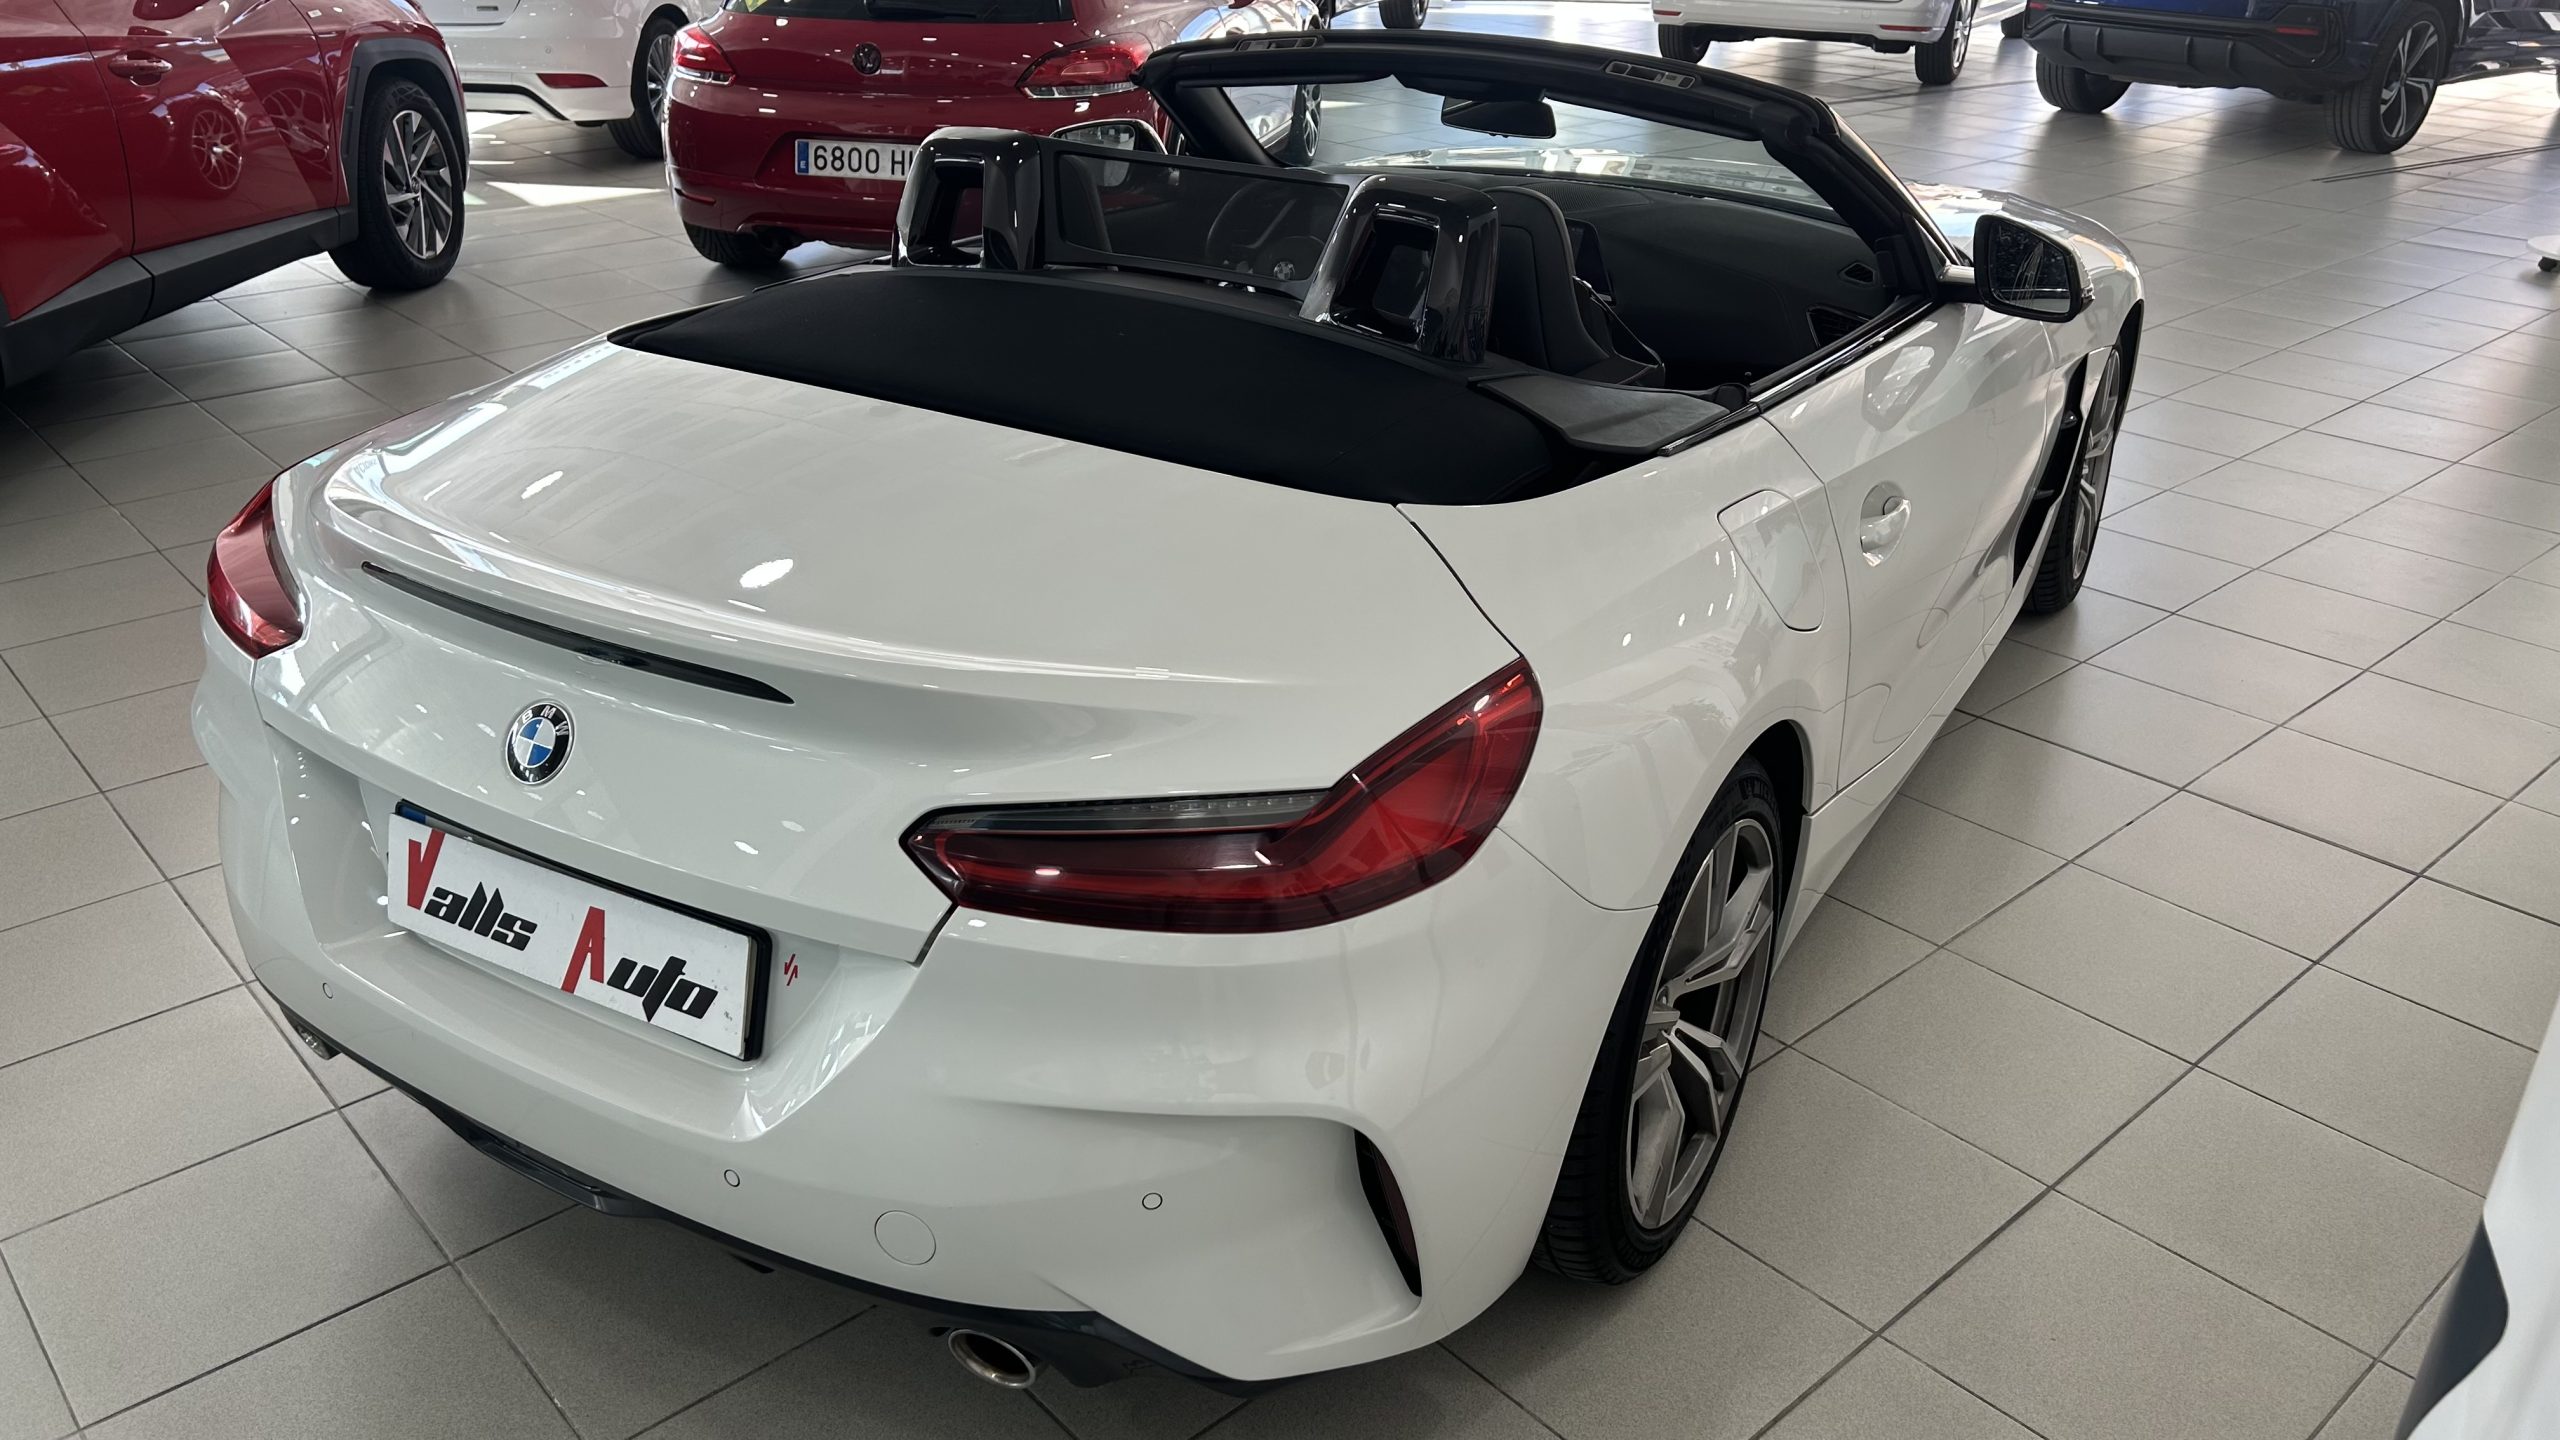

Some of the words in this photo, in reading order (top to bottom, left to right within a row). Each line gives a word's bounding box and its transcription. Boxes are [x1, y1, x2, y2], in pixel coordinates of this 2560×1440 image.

[799, 161, 807, 169] E
[813, 145, 880, 174] 6800
[521, 705, 569, 736] BMW
[407, 828, 538, 951] Valls
[561, 905, 718, 1023] Auto
